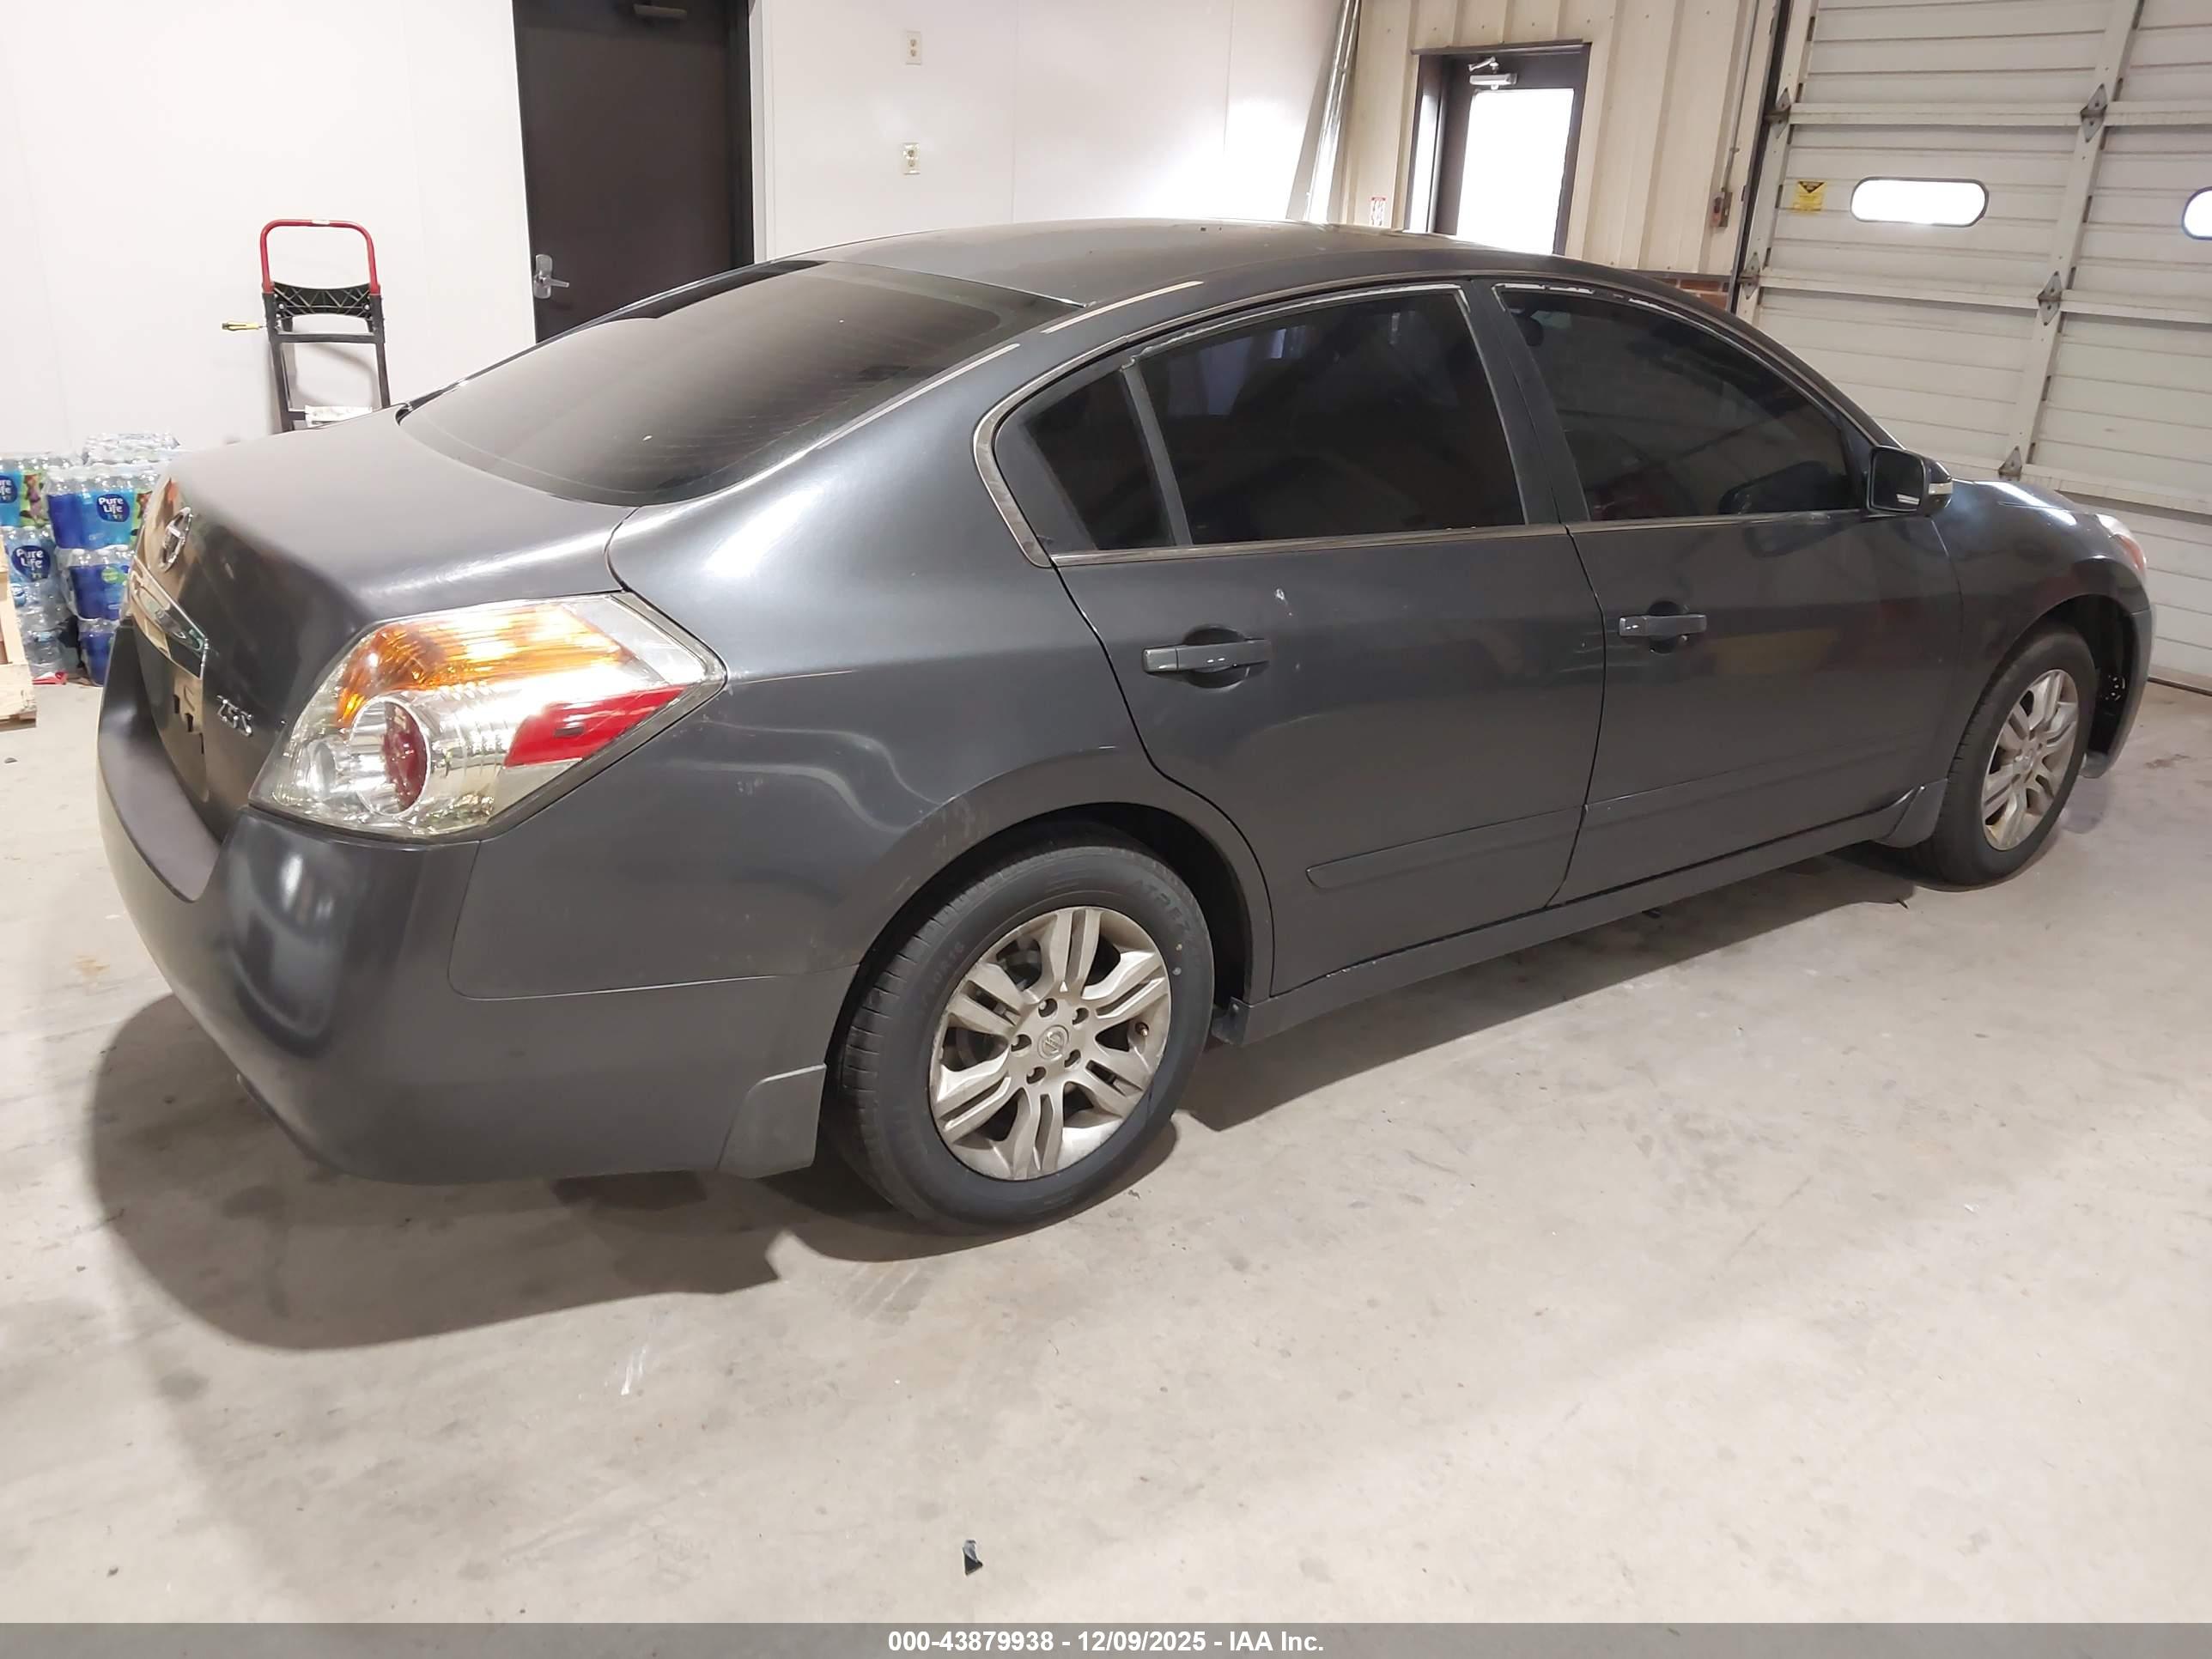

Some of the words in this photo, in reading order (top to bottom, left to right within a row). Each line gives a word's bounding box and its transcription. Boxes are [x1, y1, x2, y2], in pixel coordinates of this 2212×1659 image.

[98, 496, 124, 506] Pure
[103, 505, 123, 514] Life
[15, 549, 44, 559] Pure
[20, 557, 43, 571] Life
